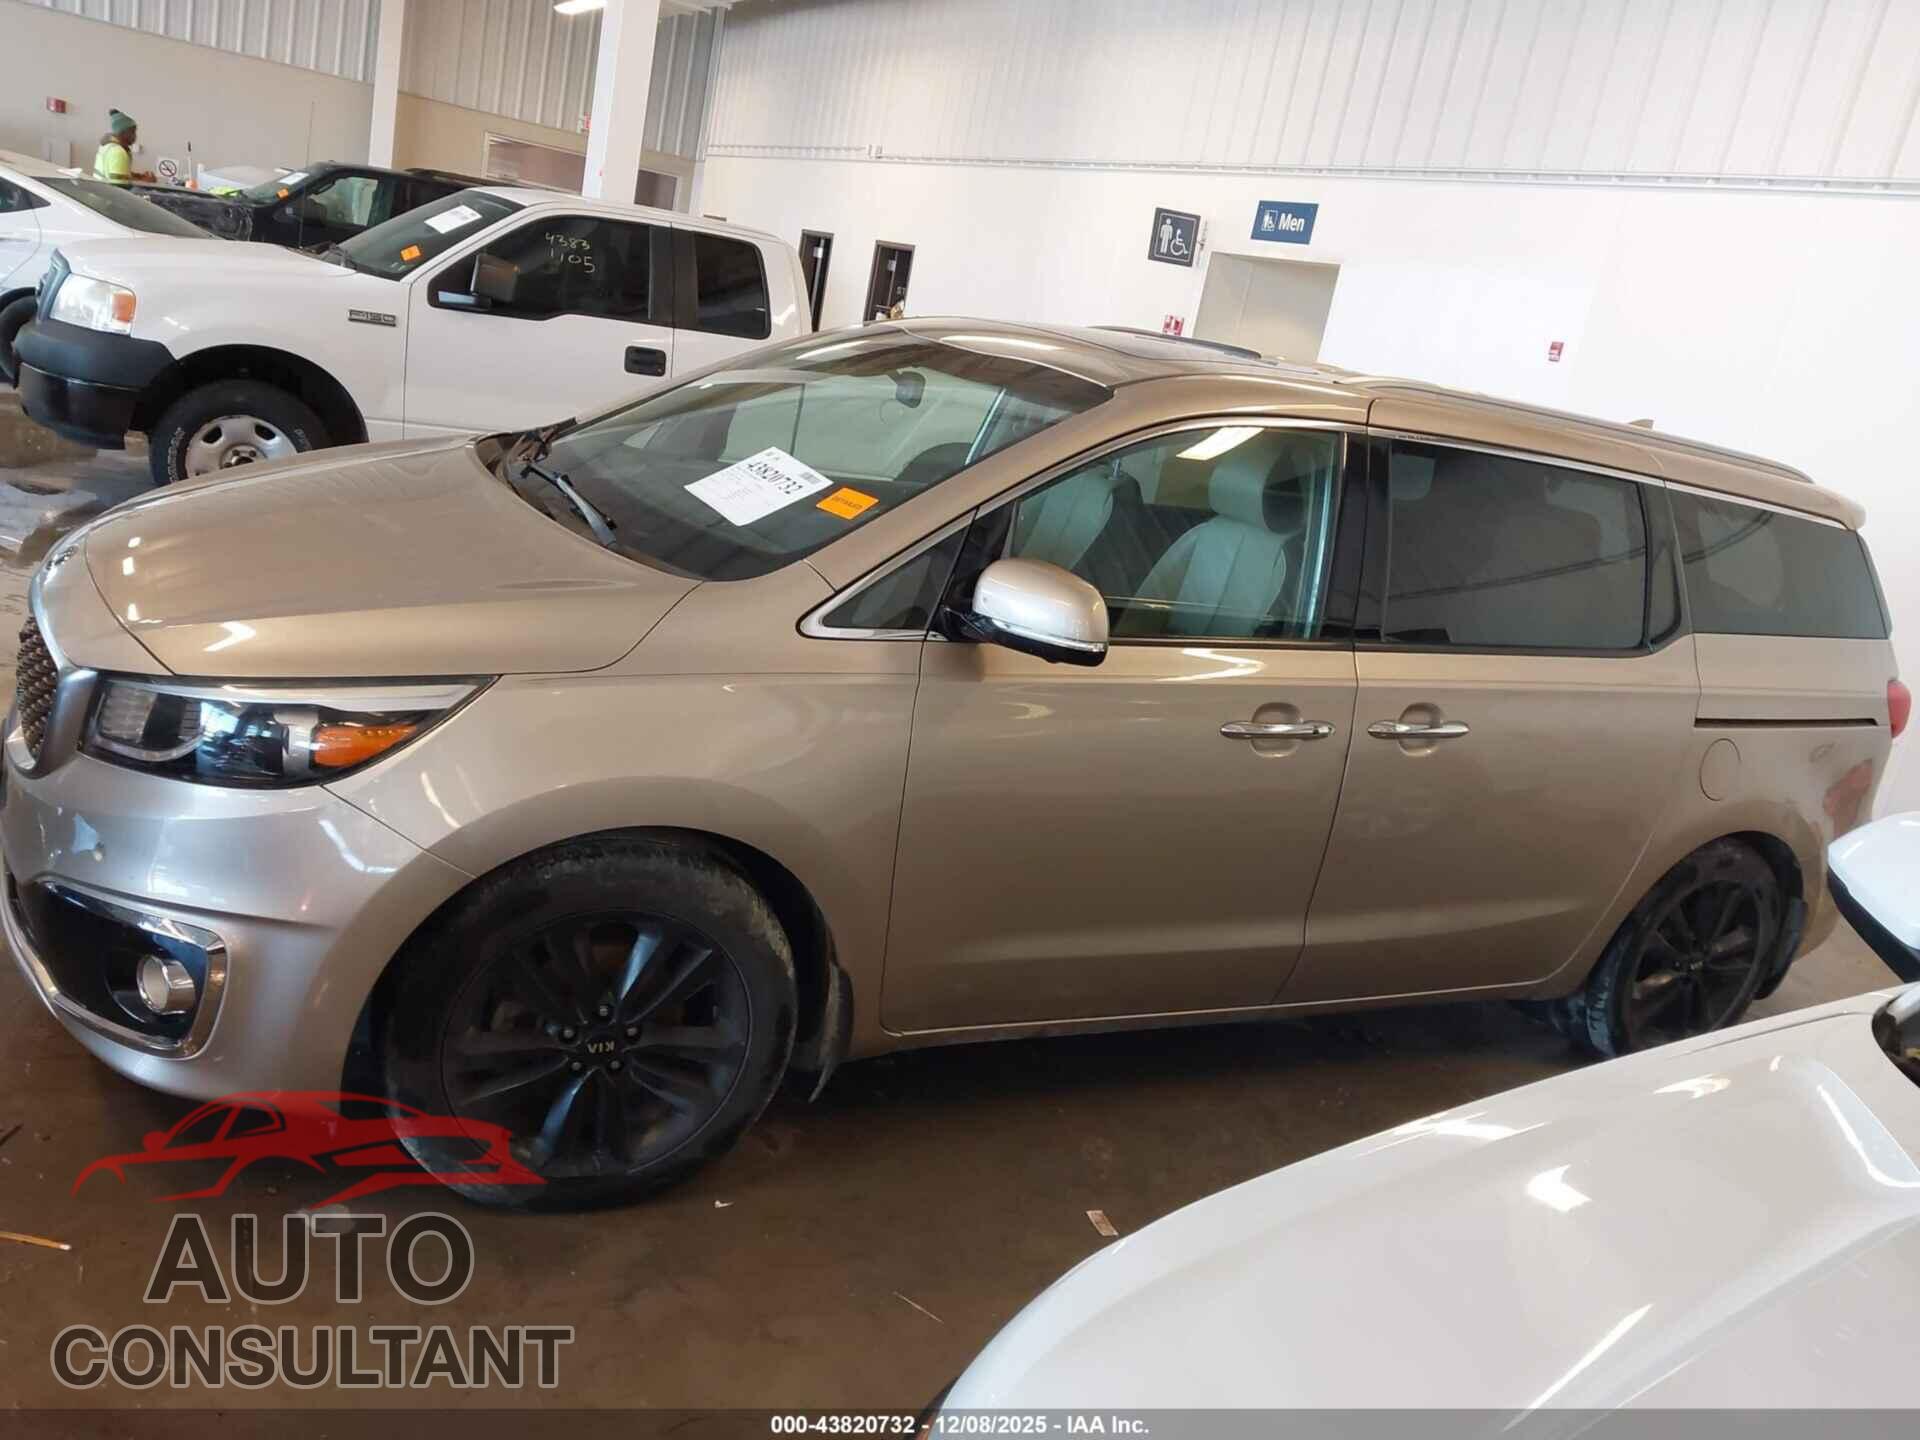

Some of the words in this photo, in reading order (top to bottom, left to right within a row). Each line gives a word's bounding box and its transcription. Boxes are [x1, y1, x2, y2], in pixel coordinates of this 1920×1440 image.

[1278, 212, 1305, 232] Men
[545, 231, 590, 250] 4383
[550, 247, 596, 273] 1105
[587, 1041, 615, 1053] KIA
